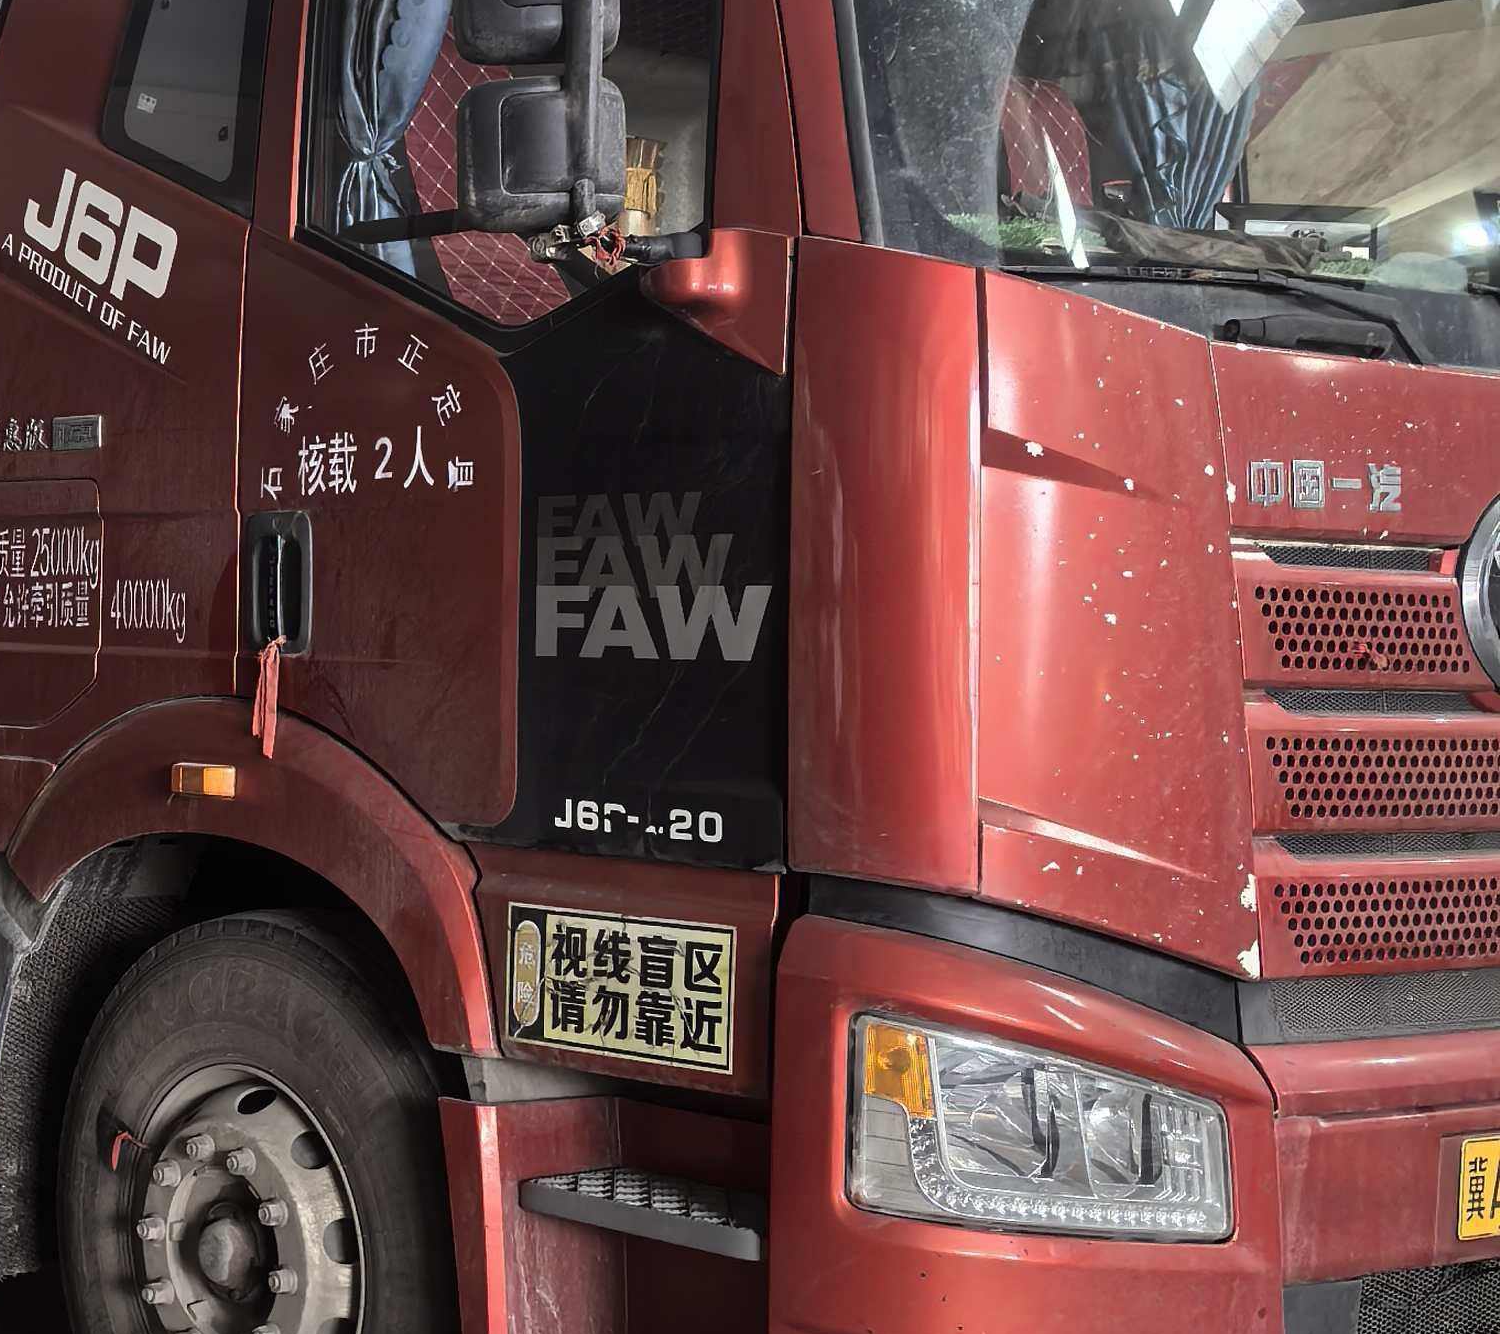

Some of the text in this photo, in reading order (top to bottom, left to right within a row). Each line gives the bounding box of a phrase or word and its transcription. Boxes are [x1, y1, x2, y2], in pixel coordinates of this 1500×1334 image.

[23, 168, 178, 301] J6P
[1, 233, 172, 365] A PRODUCT OF FAW
[537, 491, 701, 547] FAW
[1247, 458, 1402, 512] 中国一汽
[536, 533, 734, 598] FAW
[110, 578, 186, 644] 40000kg
[535, 585, 773, 661] FAW
[554, 798, 724, 843] J6P-20
[550, 924, 723, 995] 视线盲区
[550, 980, 723, 1054] 请勿靠近
